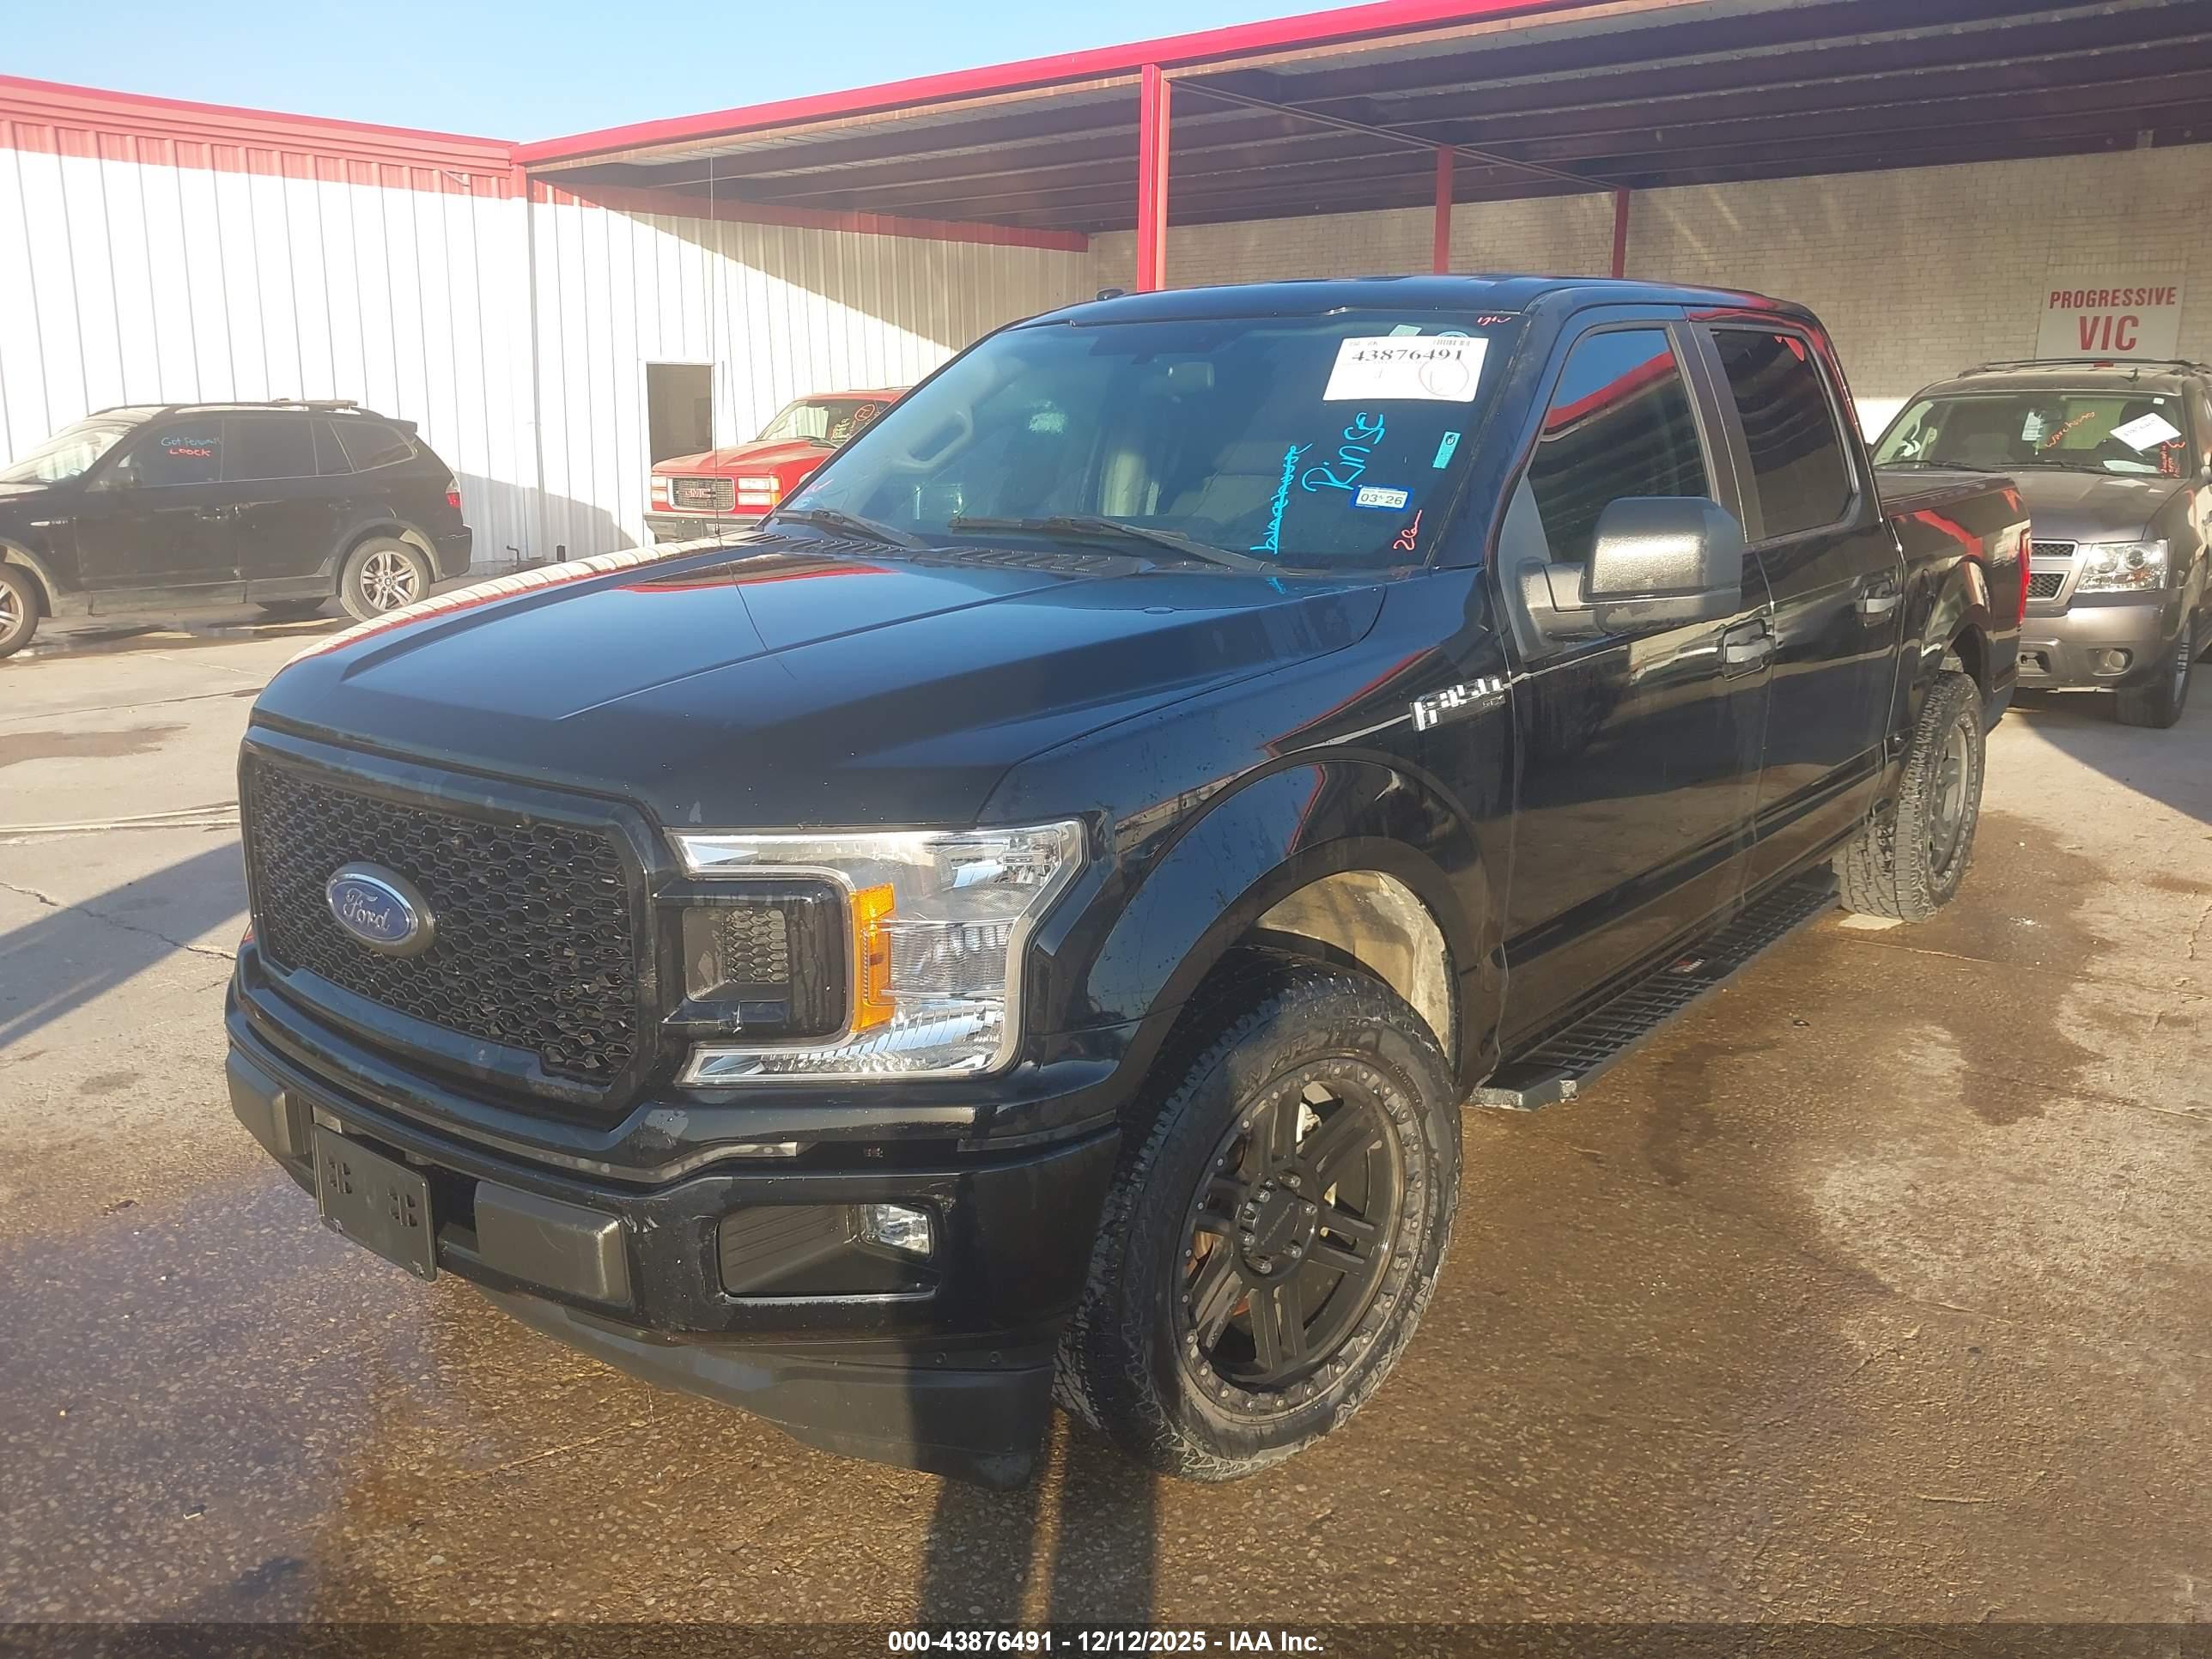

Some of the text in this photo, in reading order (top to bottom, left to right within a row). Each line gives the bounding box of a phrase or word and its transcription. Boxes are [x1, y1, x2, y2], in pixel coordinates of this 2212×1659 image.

[2049, 286, 2178, 310] PROGRESSIVE
[2079, 314, 2139, 352] VIC
[1352, 348, 1463, 362] 43876491
[1301, 411, 1386, 492] Rinse
[684, 488, 711, 498] GMC
[1360, 493, 1403, 505] 03 26
[343, 887, 391, 932] Ford
